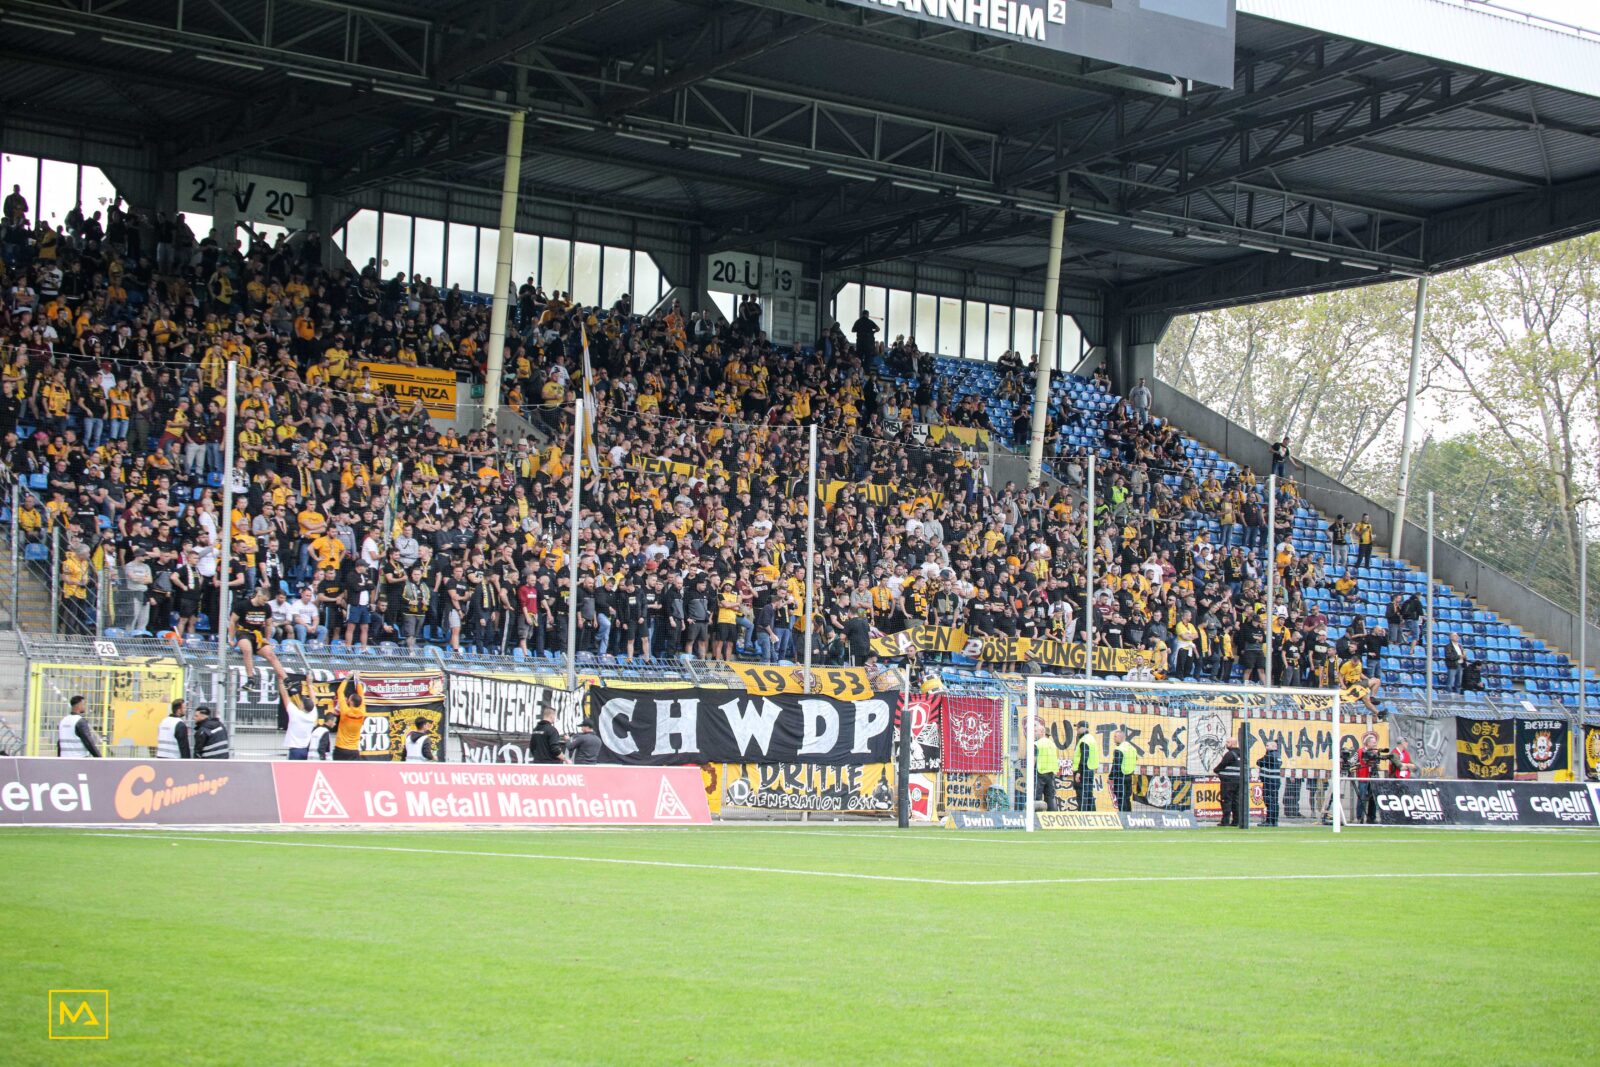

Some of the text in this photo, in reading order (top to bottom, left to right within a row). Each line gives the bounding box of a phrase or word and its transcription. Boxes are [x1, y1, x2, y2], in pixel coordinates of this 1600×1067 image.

[265, 190, 294, 216] 20
[713, 260, 736, 283] 20
[97, 643, 115, 655] 26
[745, 669, 865, 696] 19 53
[1050, 719, 1187, 760] UTRAS
[451, 772, 495, 786] NEVER
[497, 773, 540, 786] WORK
[542, 774, 584, 787] ALONE
[759, 762, 865, 793] DRITTE
[0, 773, 92, 812] erei
[115, 764, 229, 820] Grimminger
[363, 790, 637, 818] IG Metall Mannheim
[747, 793, 842, 810] GENERATION
[1377, 788, 1442, 816] capelli
[1455, 789, 1518, 817] capelli
[1530, 790, 1590, 818] capelli
[962, 814, 994, 827] bwin
[1041, 814, 1121, 828] SPORTWETTEN
[1126, 815, 1190, 828] bwin bwin
[1410, 812, 1443, 821] SPORT
[1486, 812, 1519, 821] SPORT
[1561, 812, 1591, 821] SPORT
